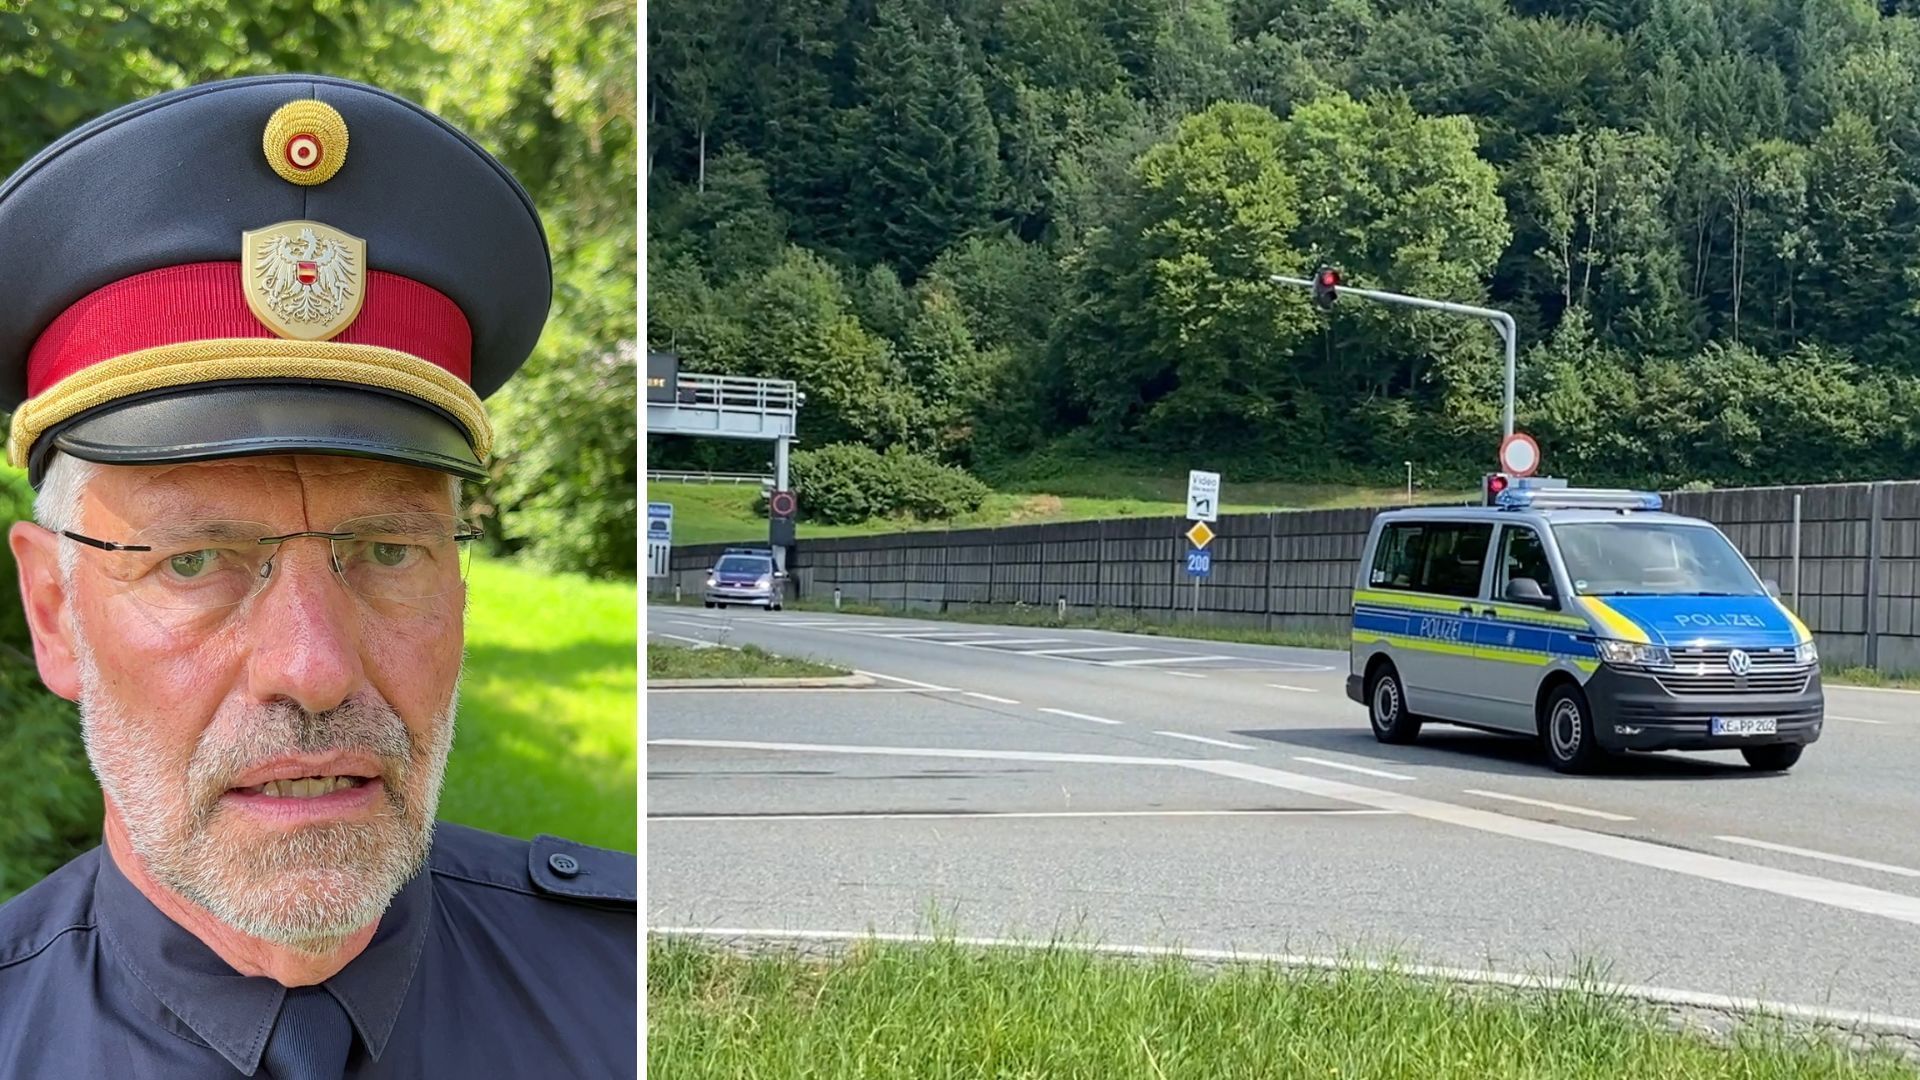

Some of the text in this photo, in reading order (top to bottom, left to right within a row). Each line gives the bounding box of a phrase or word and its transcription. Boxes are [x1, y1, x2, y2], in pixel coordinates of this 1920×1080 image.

[1192, 474, 1217, 487] Video
[1187, 555, 1209, 571] 200
[1674, 613, 1766, 628] POLIZEI
[1420, 617, 1463, 640] POLIZEI
